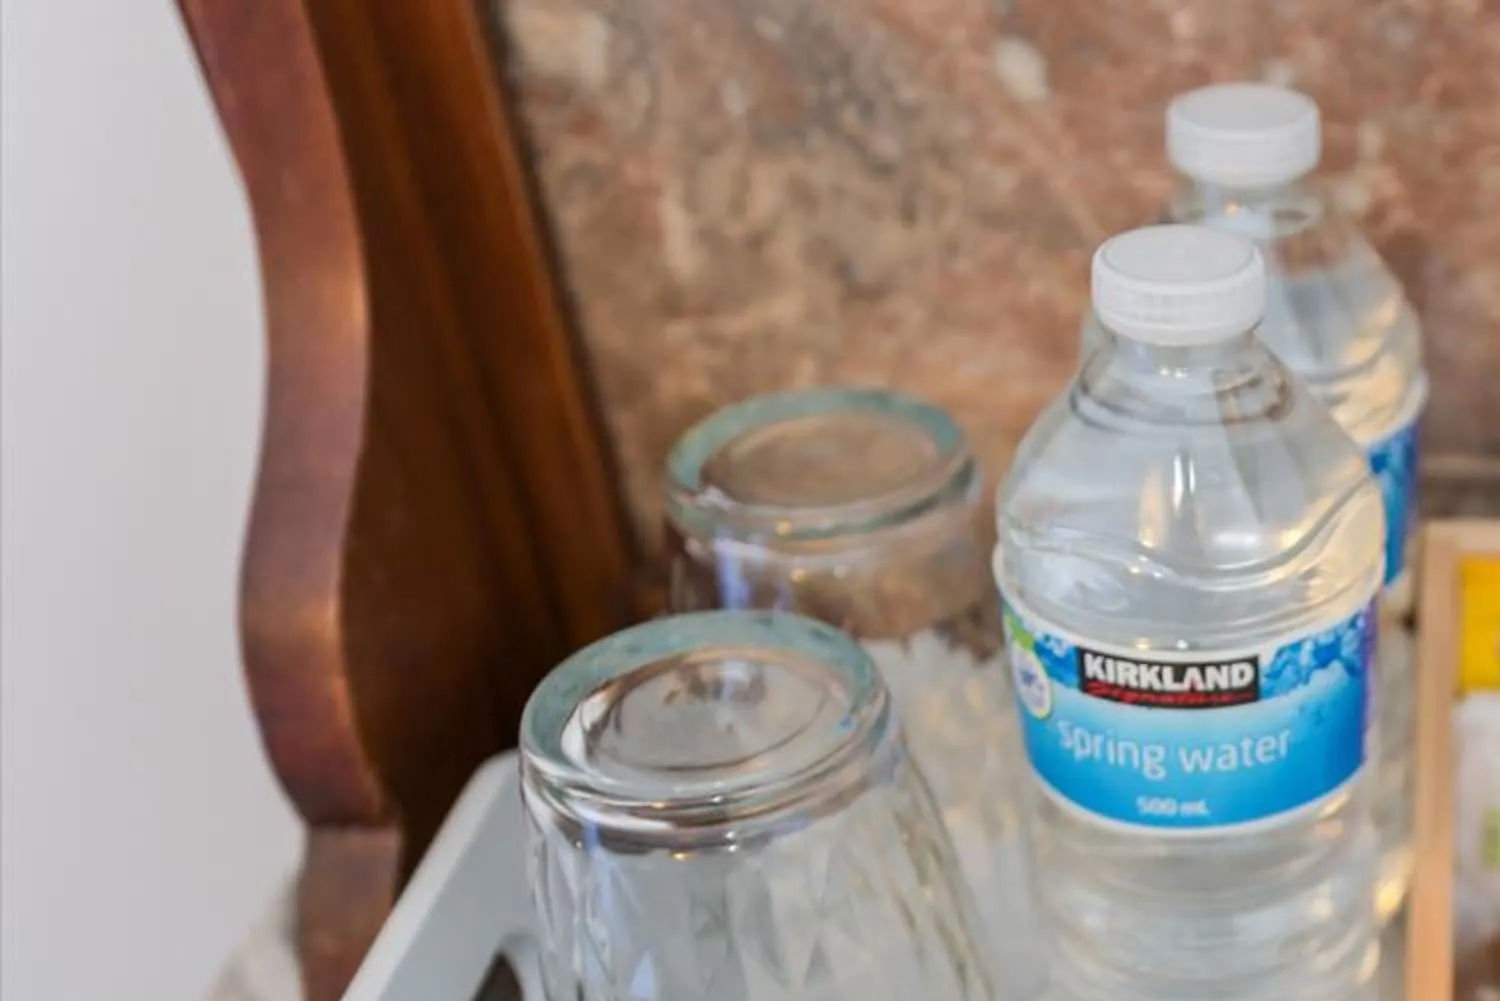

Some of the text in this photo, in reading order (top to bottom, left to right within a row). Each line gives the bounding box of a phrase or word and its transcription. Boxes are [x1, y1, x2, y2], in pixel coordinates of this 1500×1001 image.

[1084, 652, 1256, 692] KIRKLAND
[1058, 719, 1292, 780] spring water
